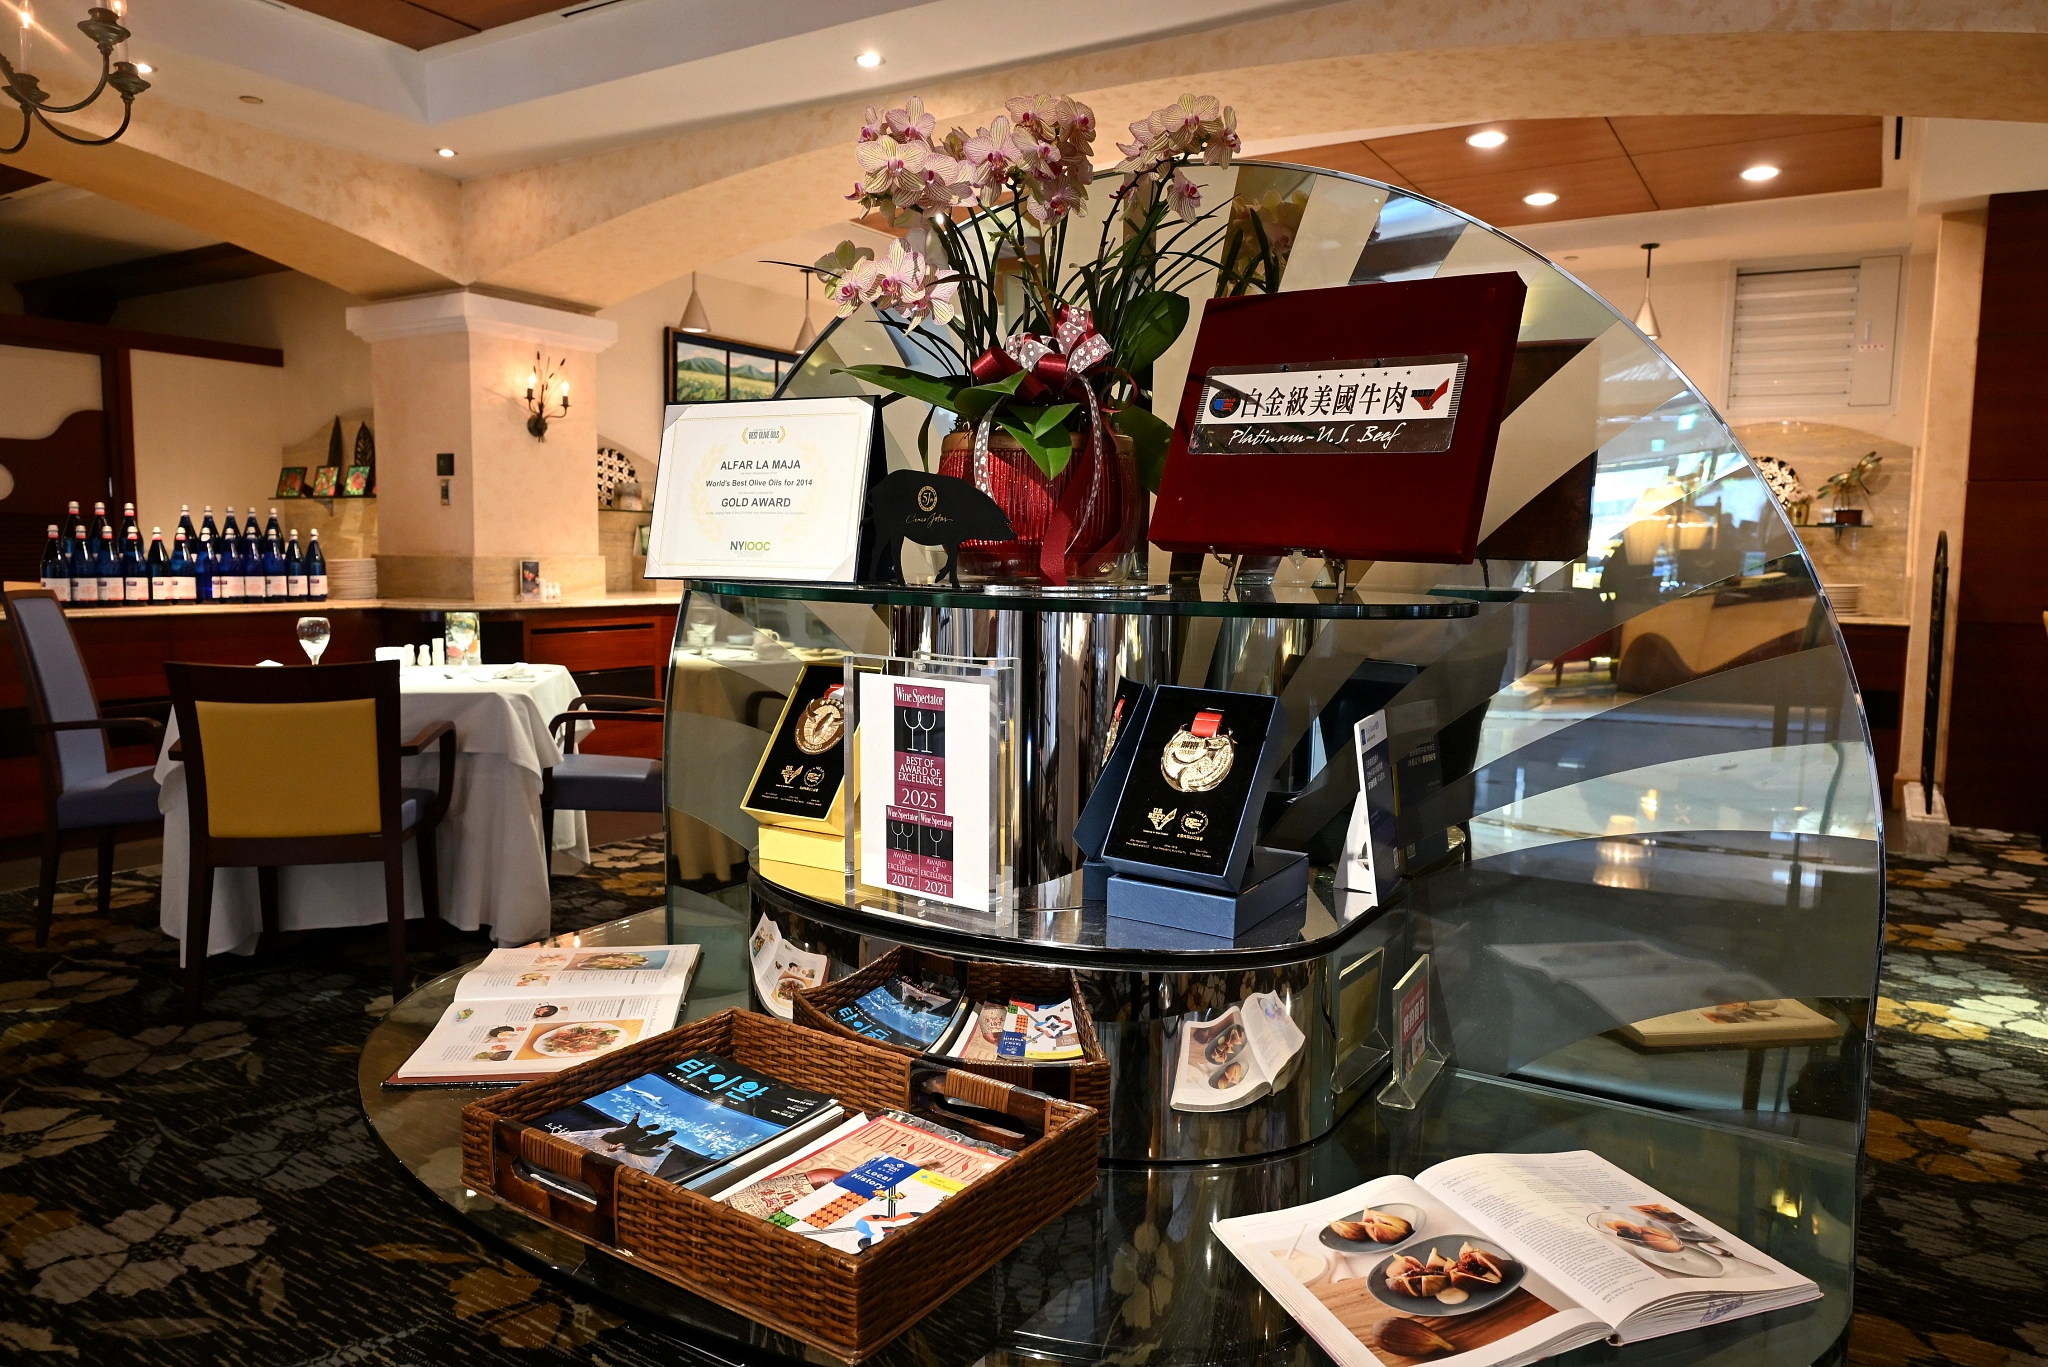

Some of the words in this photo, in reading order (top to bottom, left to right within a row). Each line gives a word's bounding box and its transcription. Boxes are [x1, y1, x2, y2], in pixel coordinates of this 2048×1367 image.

[1241, 382, 1408, 418] 白金級美國牛肉
[1357, 422, 1407, 450] Beef
[720, 460, 753, 470] ALFAR
[756, 460, 770, 470] LA
[772, 459, 801, 470] MAJA
[705, 479, 730, 487] World's
[732, 479, 747, 487] Best
[748, 479, 767, 487] Olive
[768, 479, 783, 487] Oils
[721, 497, 749, 508] GOLD
[751, 497, 791, 508] AWARD
[896, 686, 912, 702] Wine
[912, 688, 944, 707] Spectator
[906, 756, 922, 766] BEST
[924, 758, 934, 768] OF
[899, 763, 928, 776] AWARD
[930, 768, 941, 778] OF
[898, 771, 943, 787] EXCELLENCE
[902, 788, 937, 809] 2025
[887, 807, 898, 817] Wine
[897, 809, 918, 822] Spectator
[921, 813, 931, 824] Wine
[931, 815, 952, 828] Spectator
[893, 852, 912, 861] AWARD
[899, 858, 906, 866] OF
[926, 859, 947, 868] AWARD
[888, 863, 918, 875] EXCELLENCE
[921, 869, 952, 882] EXCELLENCE
[925, 880, 948, 895] 2021
[675, 1058, 770, 1102] 타이완
[850, 1173, 886, 1190] History
[864, 1168, 894, 1183] Local
